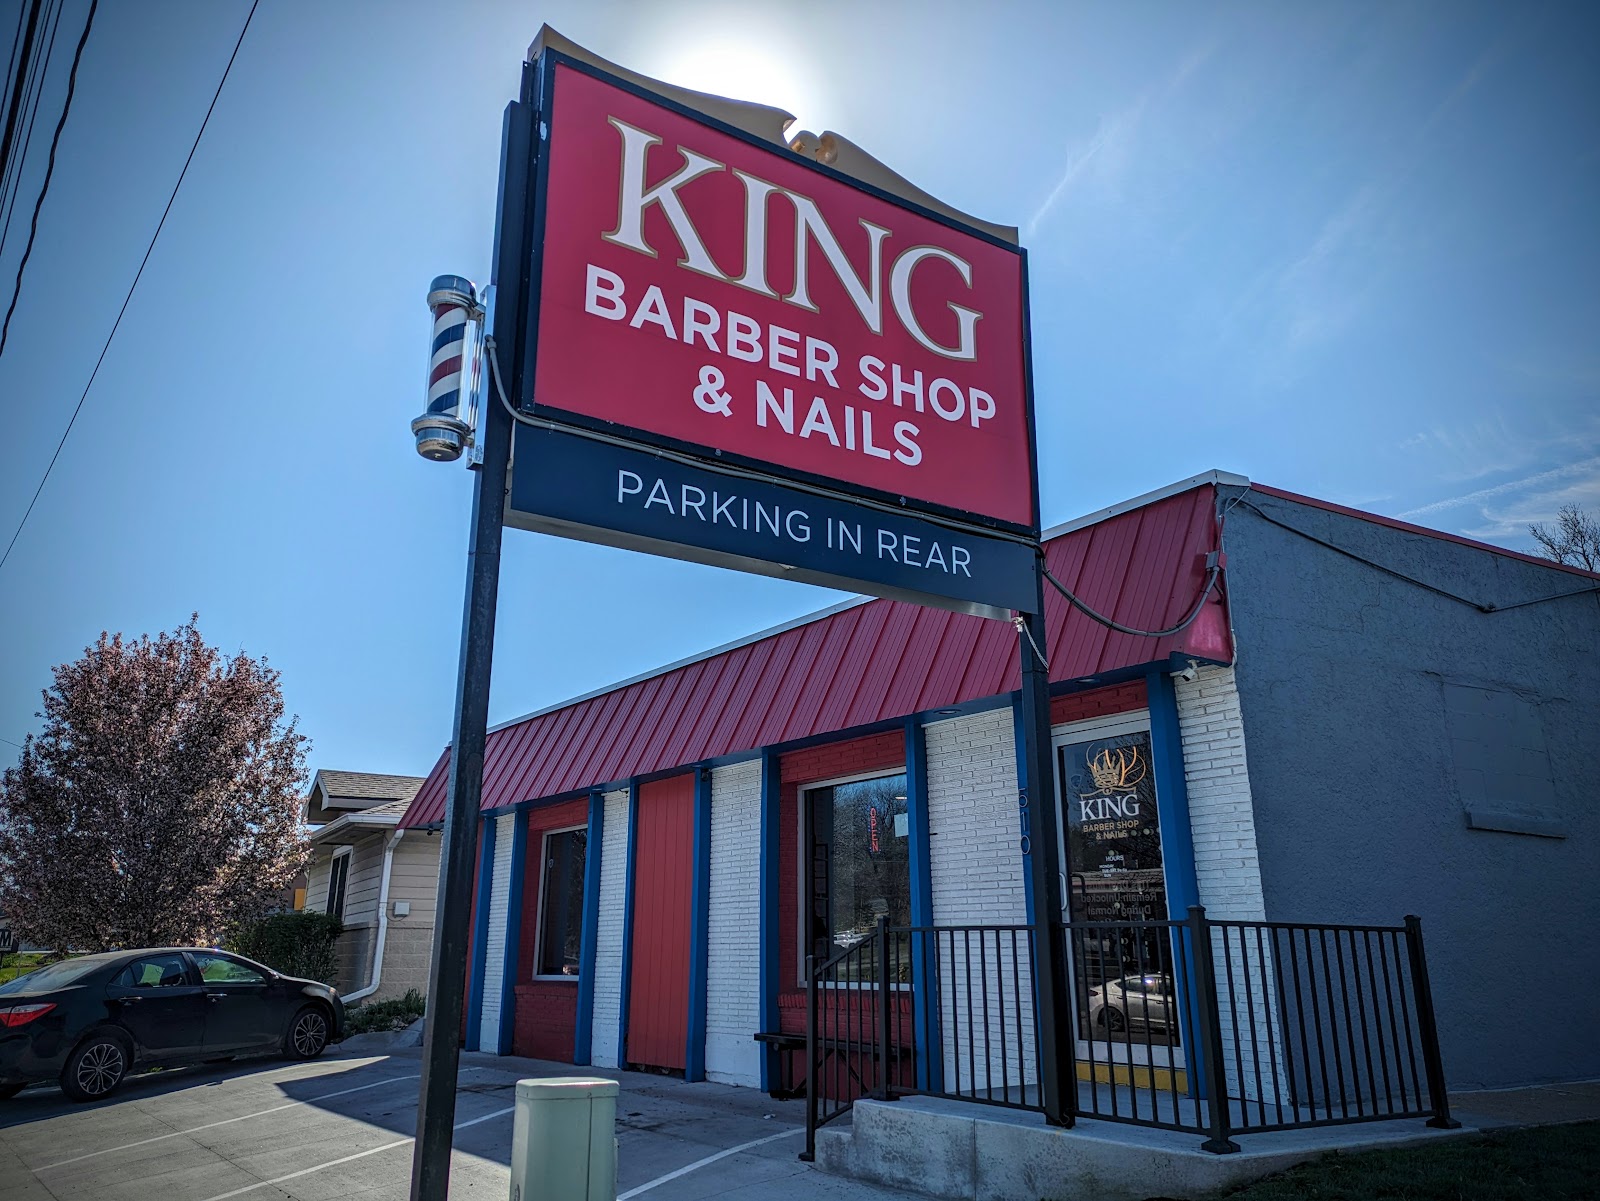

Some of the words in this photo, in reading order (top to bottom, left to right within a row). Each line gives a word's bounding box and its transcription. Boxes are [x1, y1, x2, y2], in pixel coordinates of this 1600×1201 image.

[601, 115, 984, 362] KING
[584, 263, 840, 389] BARBER
[858, 355, 996, 429] SHOP
[693, 365, 733, 419] &
[756, 380, 923, 467] NAILS
[617, 469, 812, 543] PARKING
[826, 517, 863, 555] IN
[877, 530, 973, 578] REAR
[870, 807, 879, 852] OPEN
[1018, 787, 1031, 855] 510
[1079, 794, 1140, 821] KING
[1083, 822, 1115, 833] BARBER
[1116, 819, 1139, 829] SHOP
[1095, 832, 1102, 841] &
[1103, 829, 1128, 840] NAILS
[1105, 854, 1124, 862] HOURS
